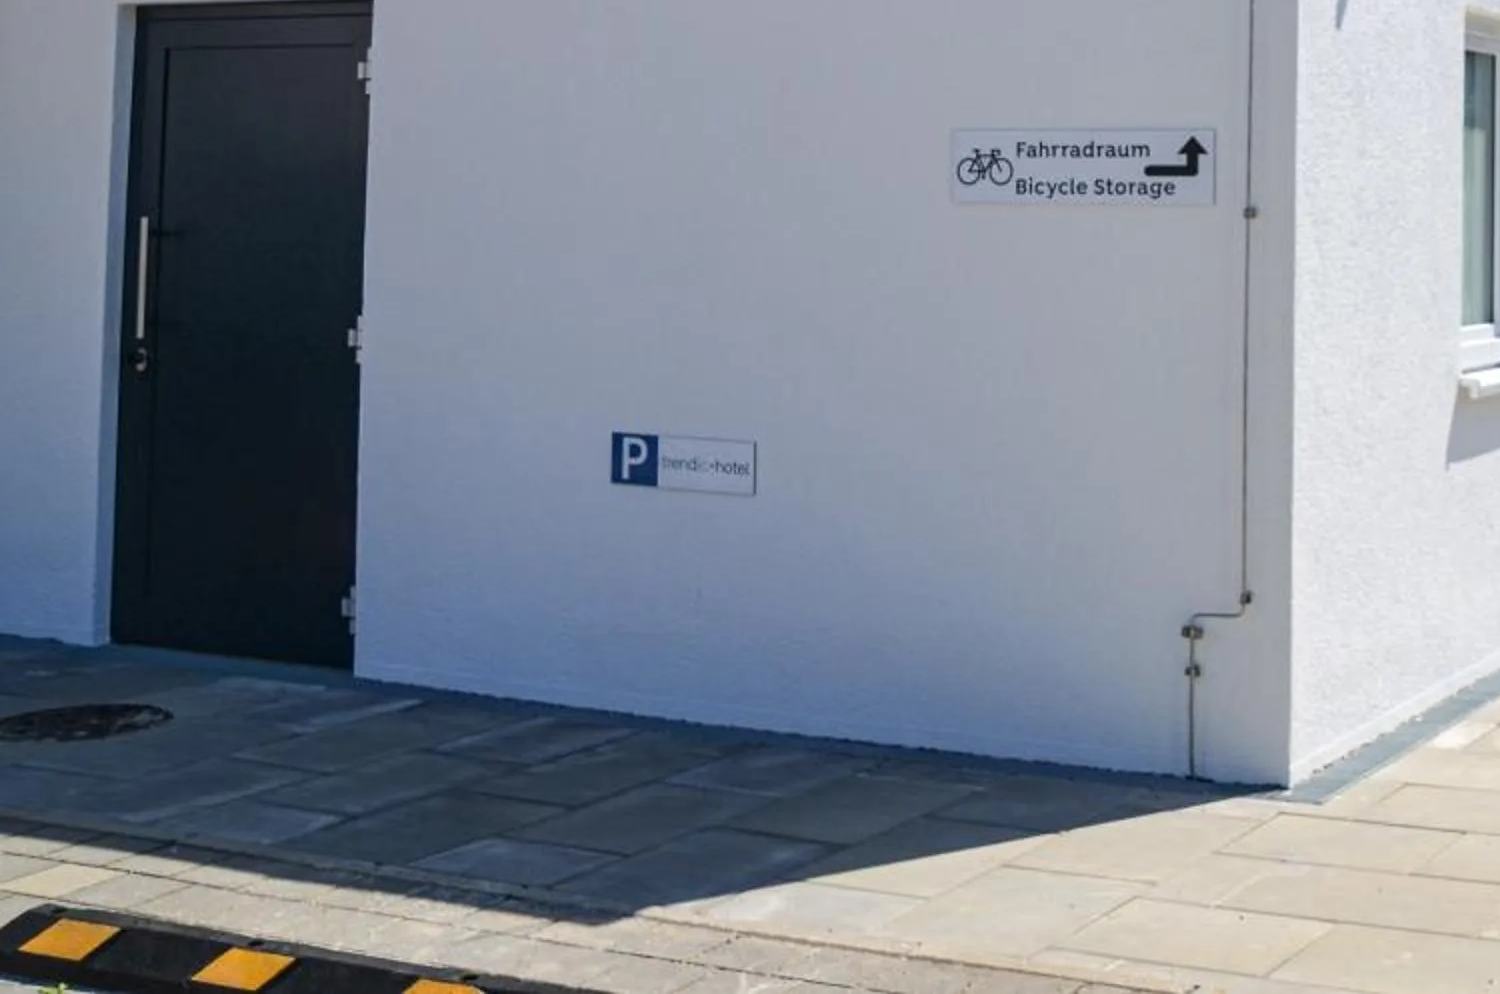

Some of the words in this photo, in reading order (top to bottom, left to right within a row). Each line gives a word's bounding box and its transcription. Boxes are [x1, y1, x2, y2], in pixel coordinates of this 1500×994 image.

[1015, 141, 1151, 158] Fahrradraum
[1015, 178, 1088, 199] Bicycle
[1093, 178, 1176, 199] Storage
[621, 436, 649, 480] P
